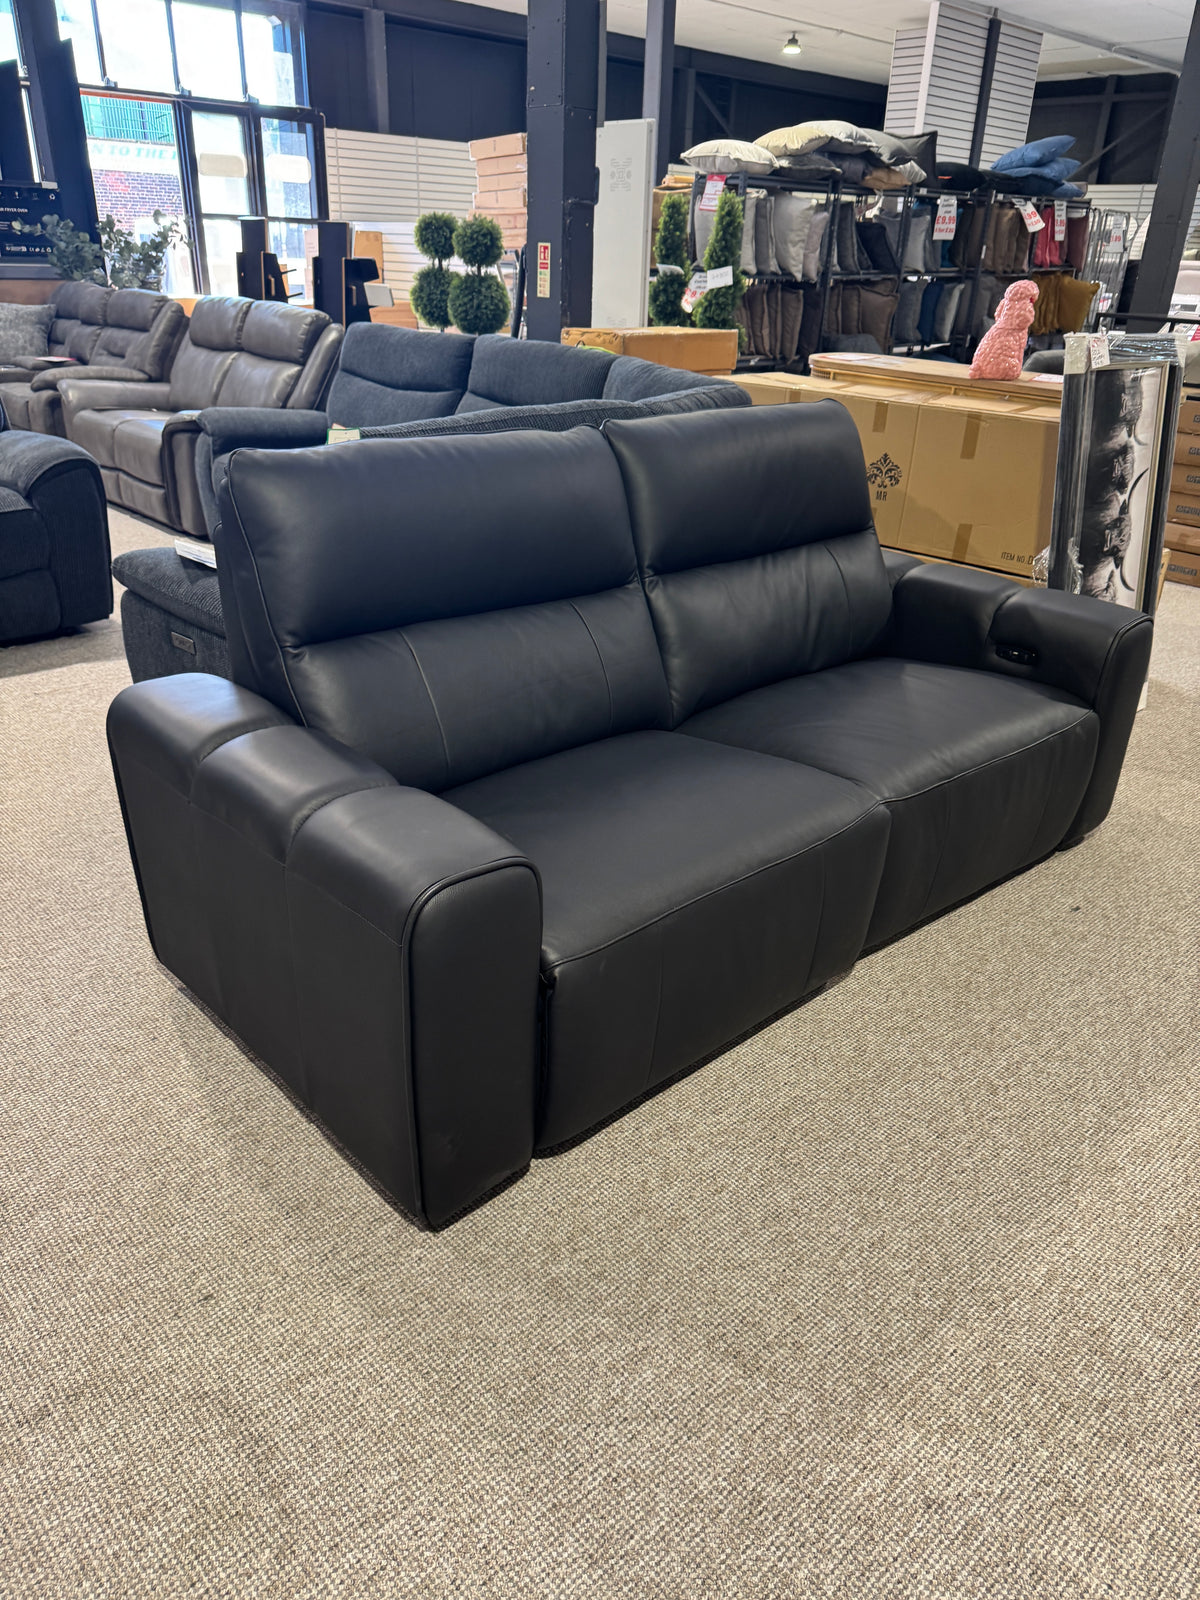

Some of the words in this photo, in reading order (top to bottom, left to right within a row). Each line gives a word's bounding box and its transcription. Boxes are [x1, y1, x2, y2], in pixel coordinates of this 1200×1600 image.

[109, 145, 130, 156] TO
[136, 147, 168, 160] THE
[876, 490, 888, 501] MR
[1001, 551, 1016, 561] ITEM
